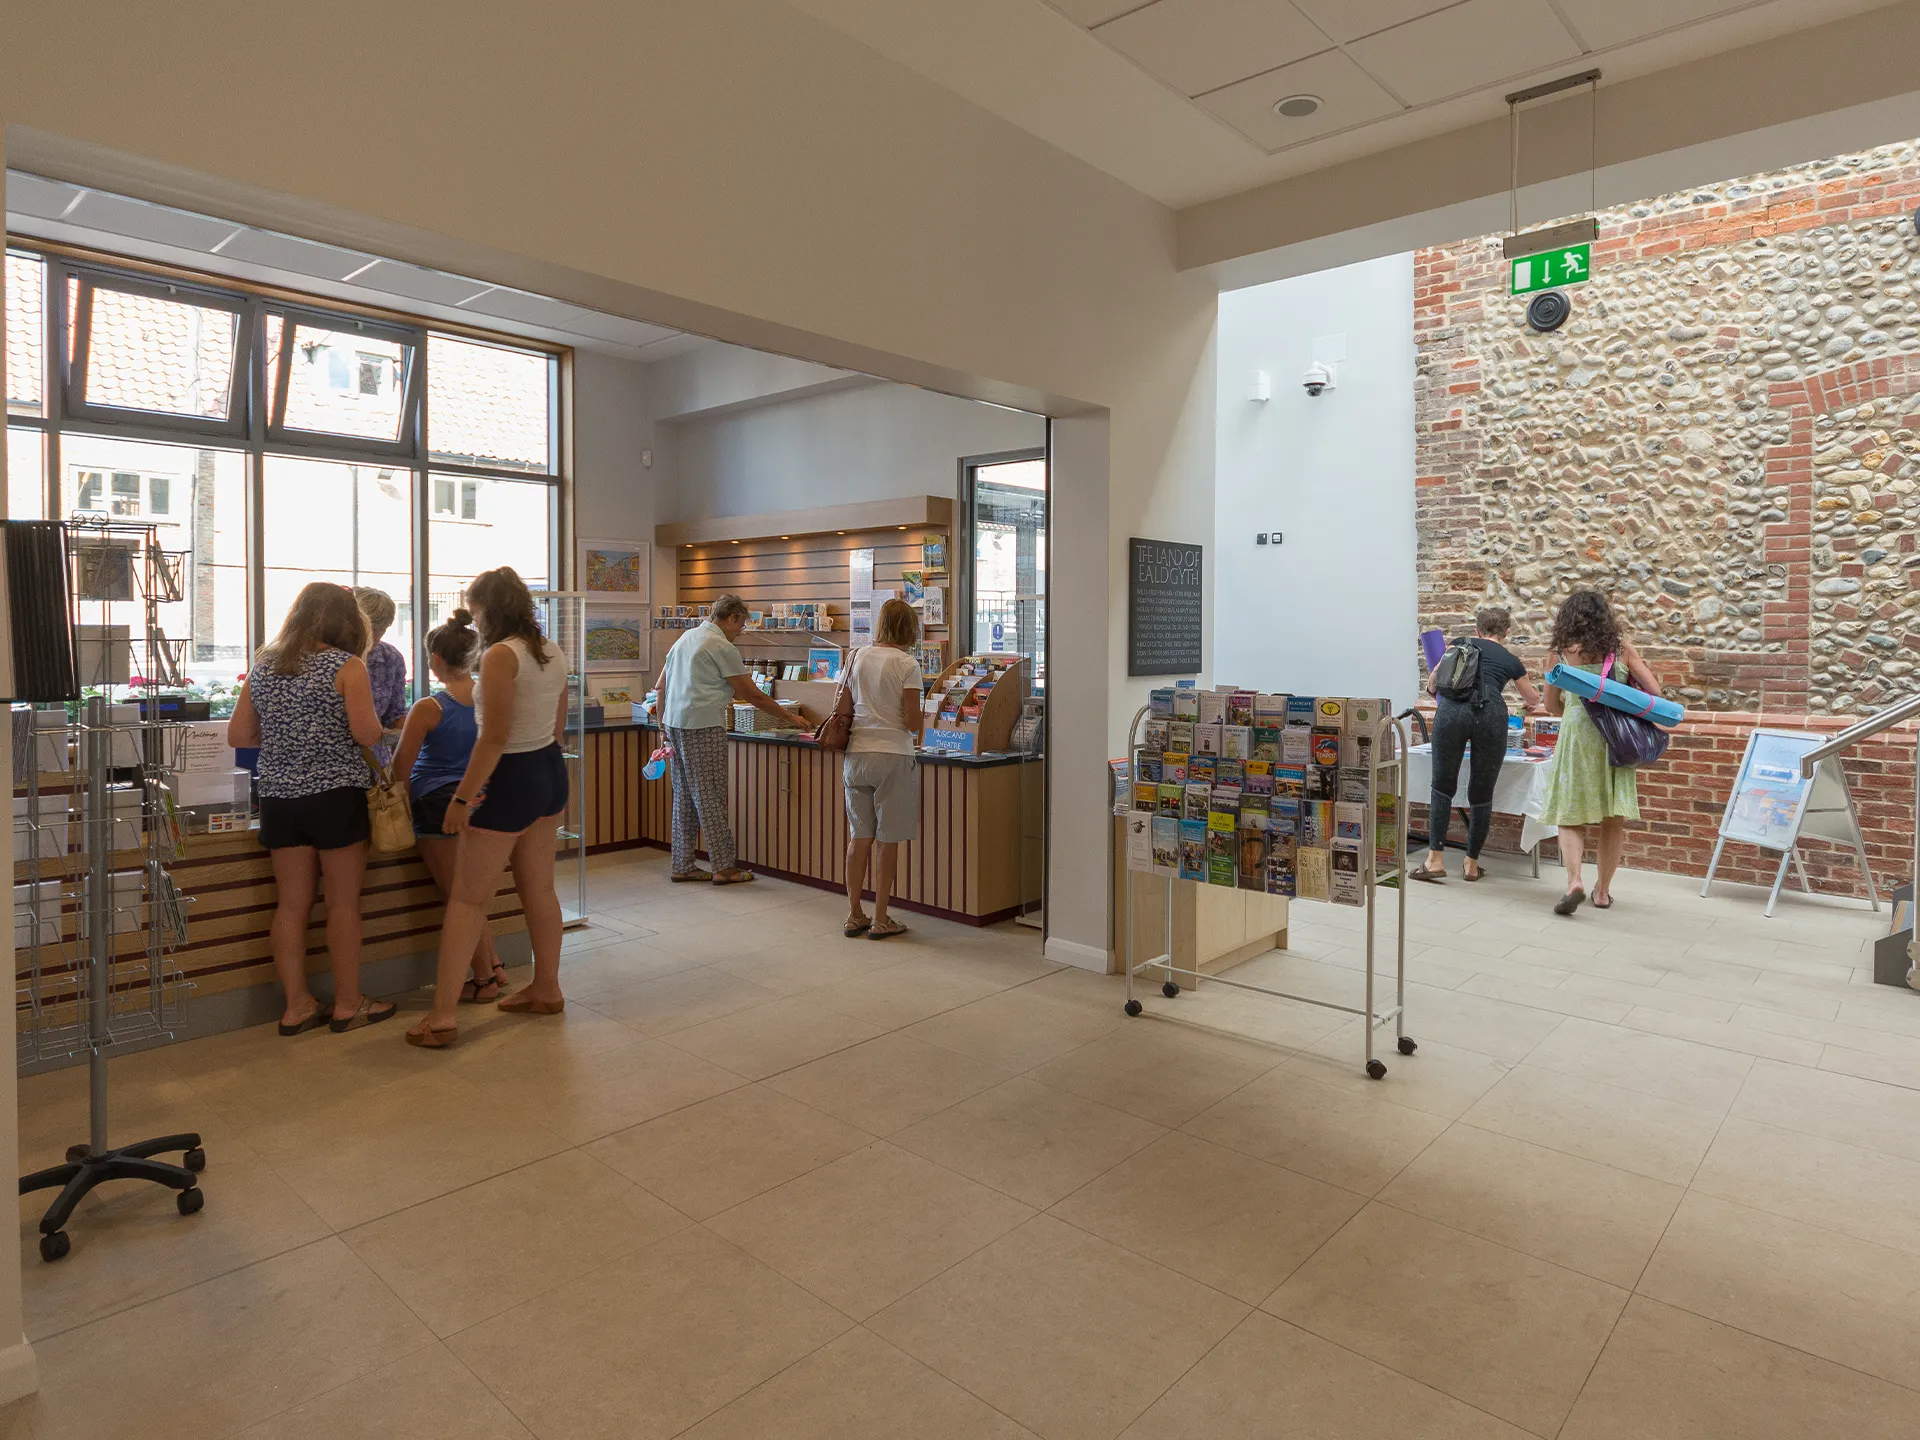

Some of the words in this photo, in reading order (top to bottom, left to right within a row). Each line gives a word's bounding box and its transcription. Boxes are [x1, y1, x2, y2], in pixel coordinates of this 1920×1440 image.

[1136, 545, 1154, 564] THE
[1156, 547, 1183, 568] LAND
[1184, 550, 1200, 568] OF
[1138, 563, 1200, 586] EALDGYTH
[932, 729, 952, 739] MUSIC
[951, 731, 967, 740] AND
[935, 739, 962, 749] THEATRE
